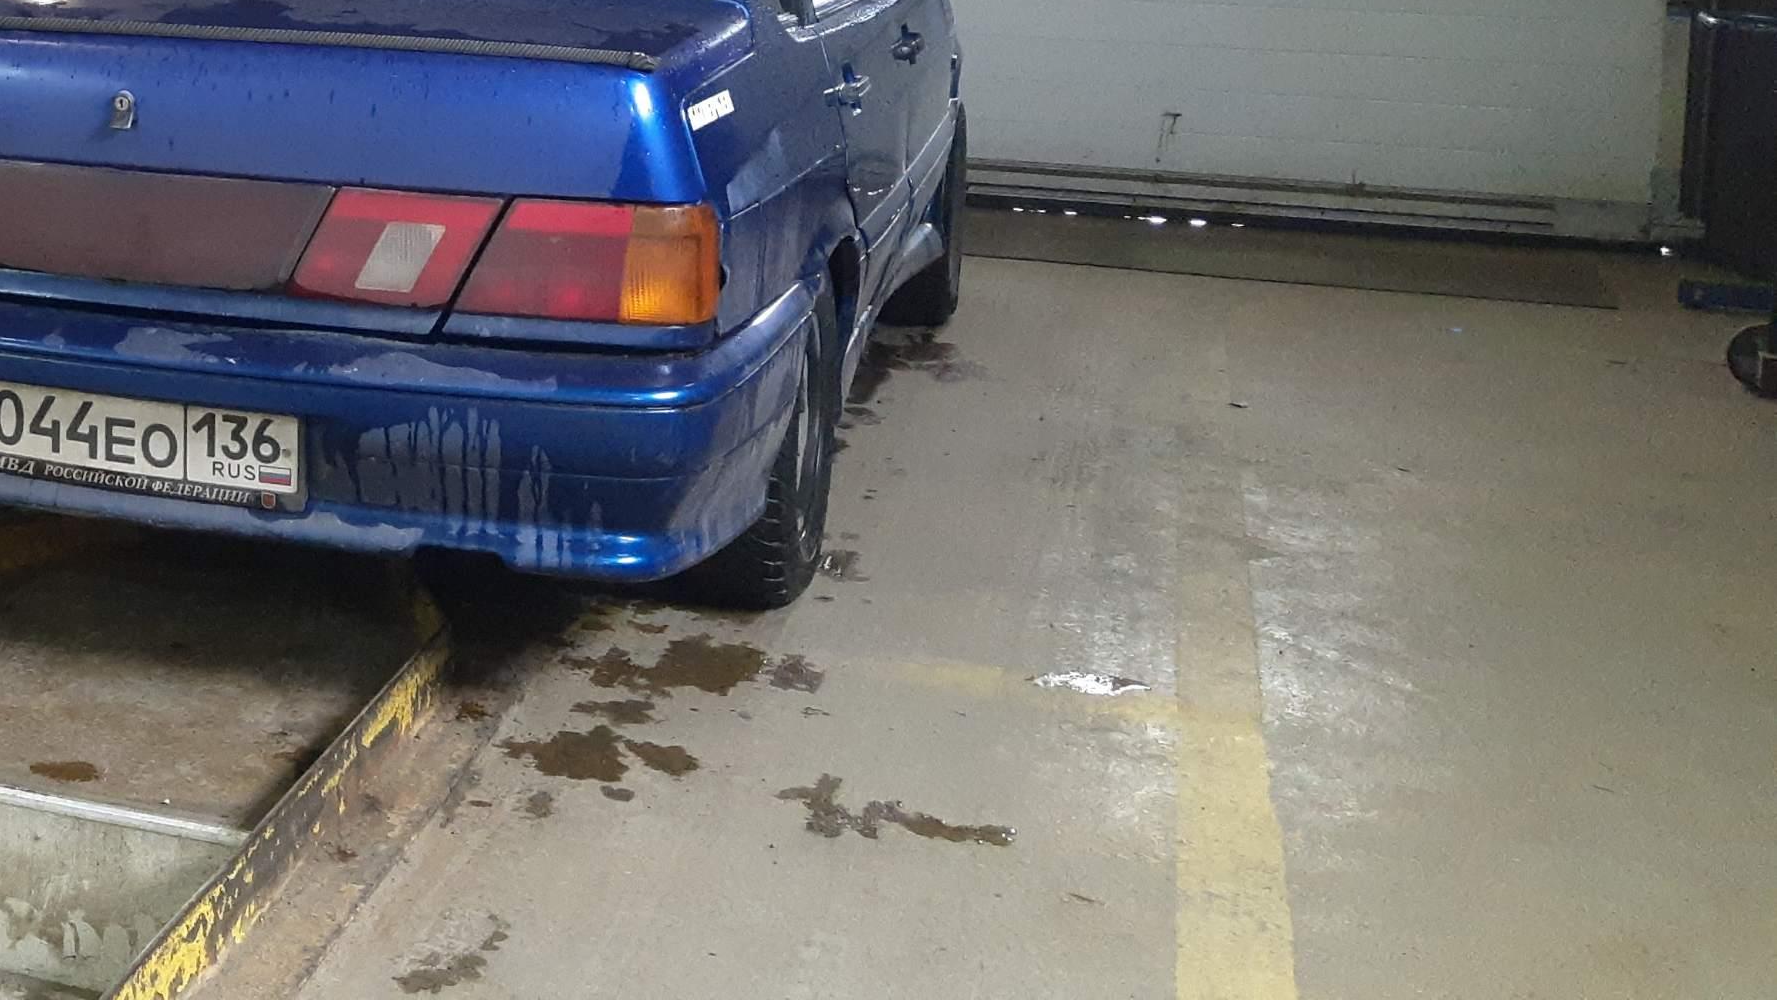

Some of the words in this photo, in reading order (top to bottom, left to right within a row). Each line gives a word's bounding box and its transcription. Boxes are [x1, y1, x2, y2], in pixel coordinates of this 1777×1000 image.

[191, 412, 281, 464] 136
[44, 463, 148, 490] РОССИЙСКОЙ
[151, 480, 250, 504] ФЕДЕРАЦИИ
[212, 461, 256, 481] RUS
